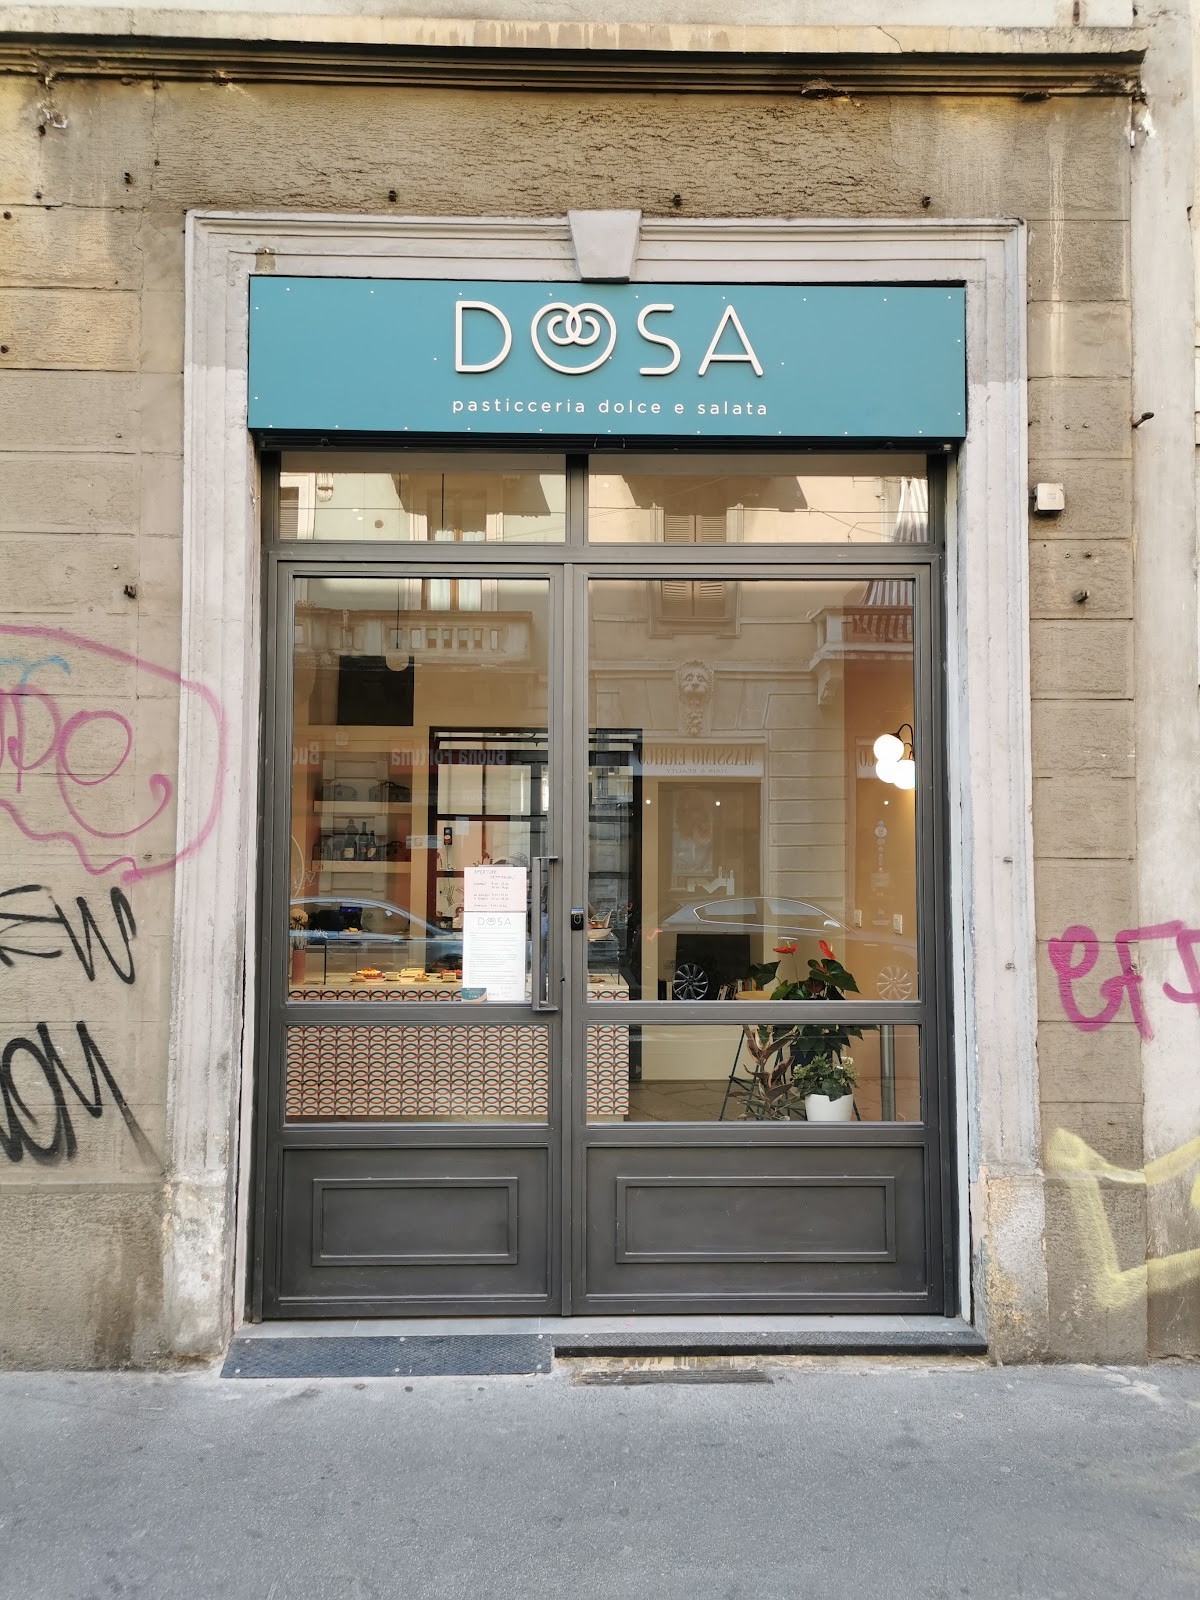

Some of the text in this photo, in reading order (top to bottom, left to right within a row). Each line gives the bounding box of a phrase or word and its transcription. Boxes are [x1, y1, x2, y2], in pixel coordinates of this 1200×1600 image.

[455, 300, 764, 377] DOSA
[452, 399, 768, 416] pasticceria dolce e salata
[477, 916, 512, 927] DOSA
